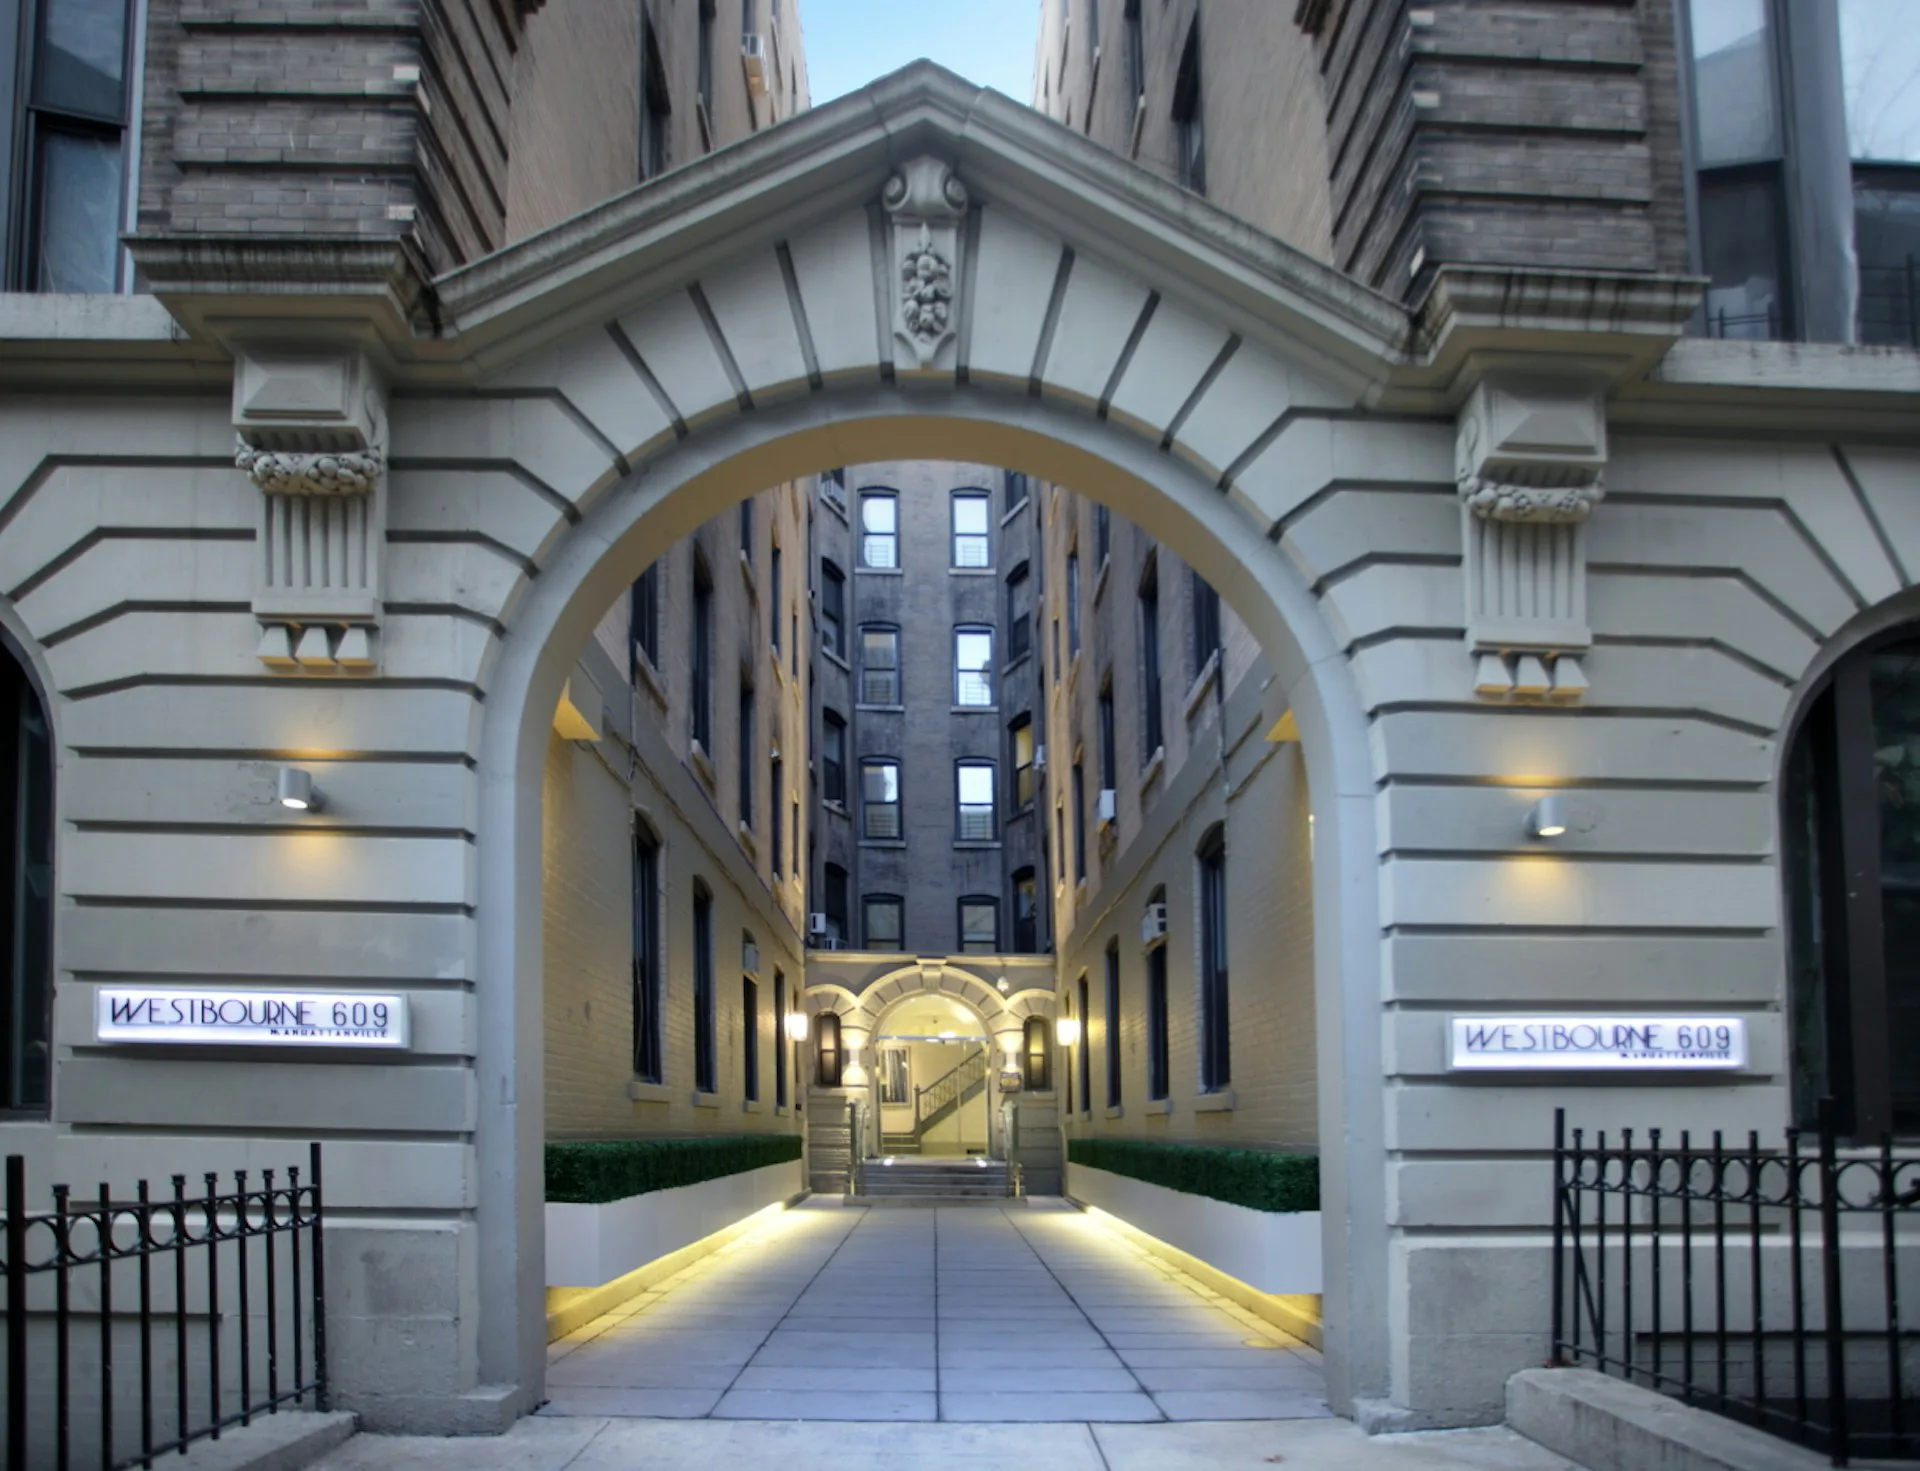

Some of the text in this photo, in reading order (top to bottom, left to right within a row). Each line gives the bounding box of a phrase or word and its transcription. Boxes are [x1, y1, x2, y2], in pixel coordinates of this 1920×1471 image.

[111, 997, 389, 1028] WESTBOURNE 609
[270, 1027, 388, 1038] MANHATTANVILLE
[1466, 1024, 1731, 1051] WESTBOURNE 609
